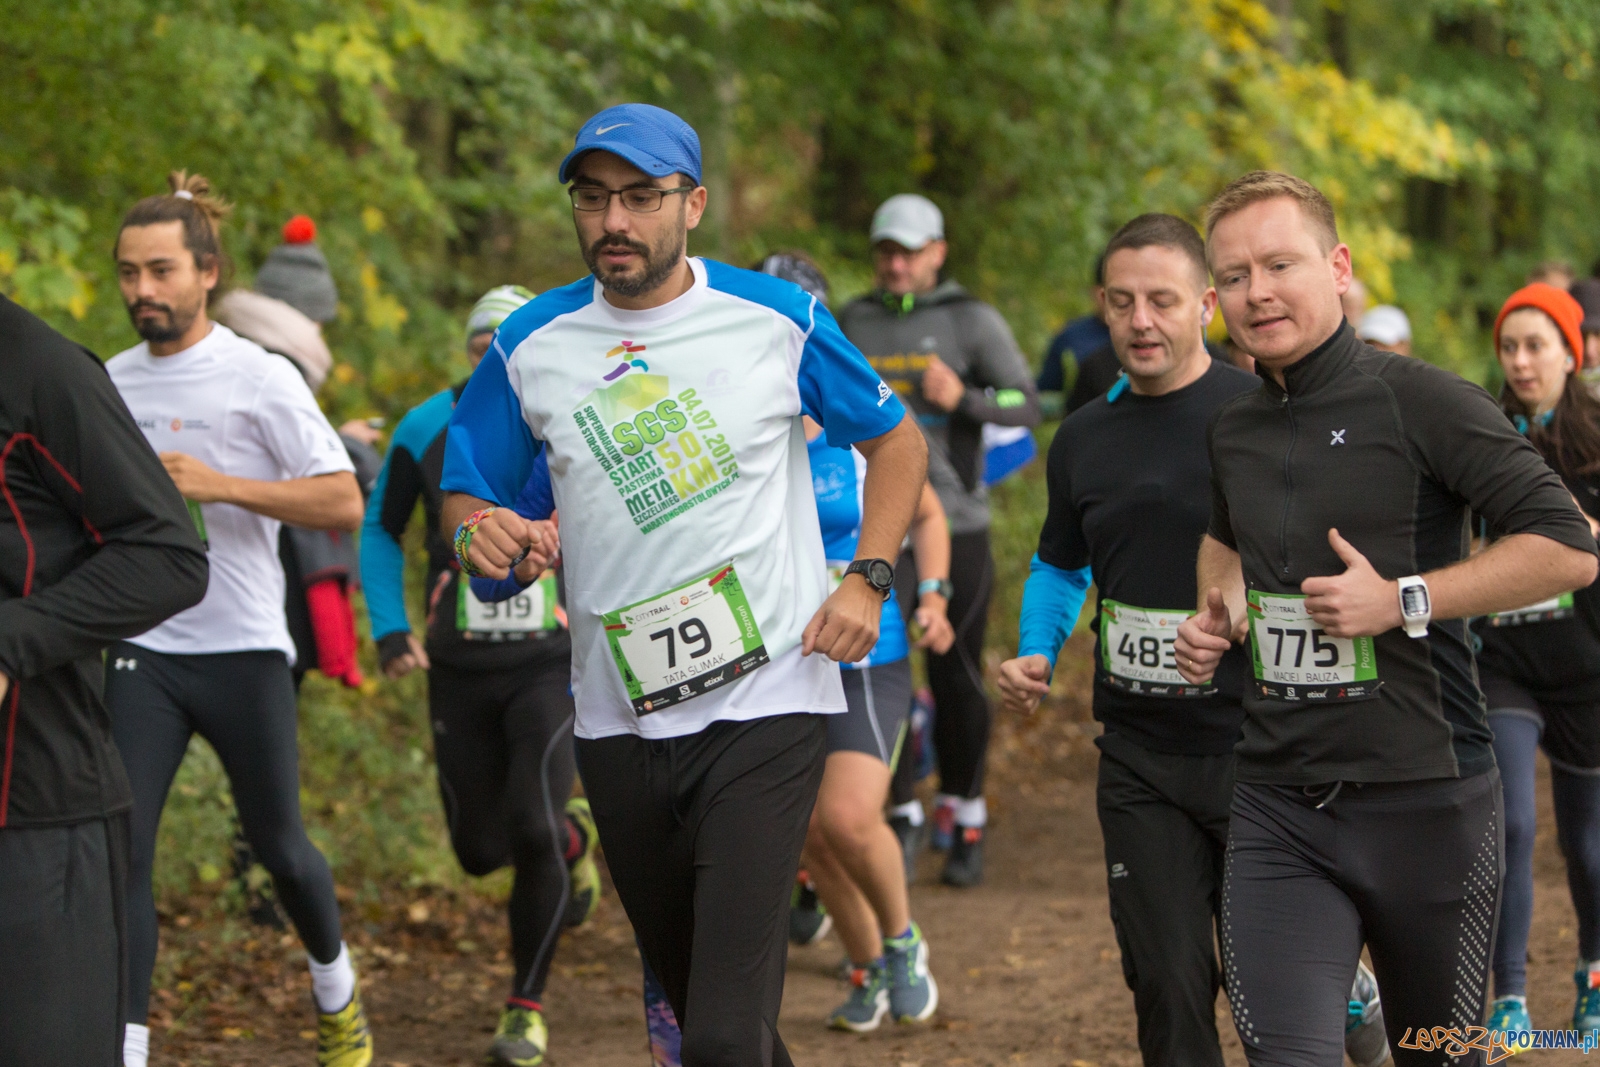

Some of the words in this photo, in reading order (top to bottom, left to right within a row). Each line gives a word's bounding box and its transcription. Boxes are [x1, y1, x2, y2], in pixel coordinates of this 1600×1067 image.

[583, 405, 625, 466] SUPERMARATON
[611, 399, 688, 456] SGS
[581, 426, 614, 472] STOŁOWYCH
[608, 450, 658, 487] START
[617, 467, 665, 498] PASTERKA
[668, 456, 719, 500] KM
[624, 478, 675, 517] META
[633, 494, 681, 526] SZCZELINIEC
[736, 605, 755, 638] Poznań
[649, 617, 712, 669] 79
[1117, 632, 1178, 670] 483
[1266, 626, 1339, 668] 775
[662, 669, 688, 685] TATA
[1273, 671, 1300, 682] MACIEJ
[1306, 672, 1340, 683] BAUZA
